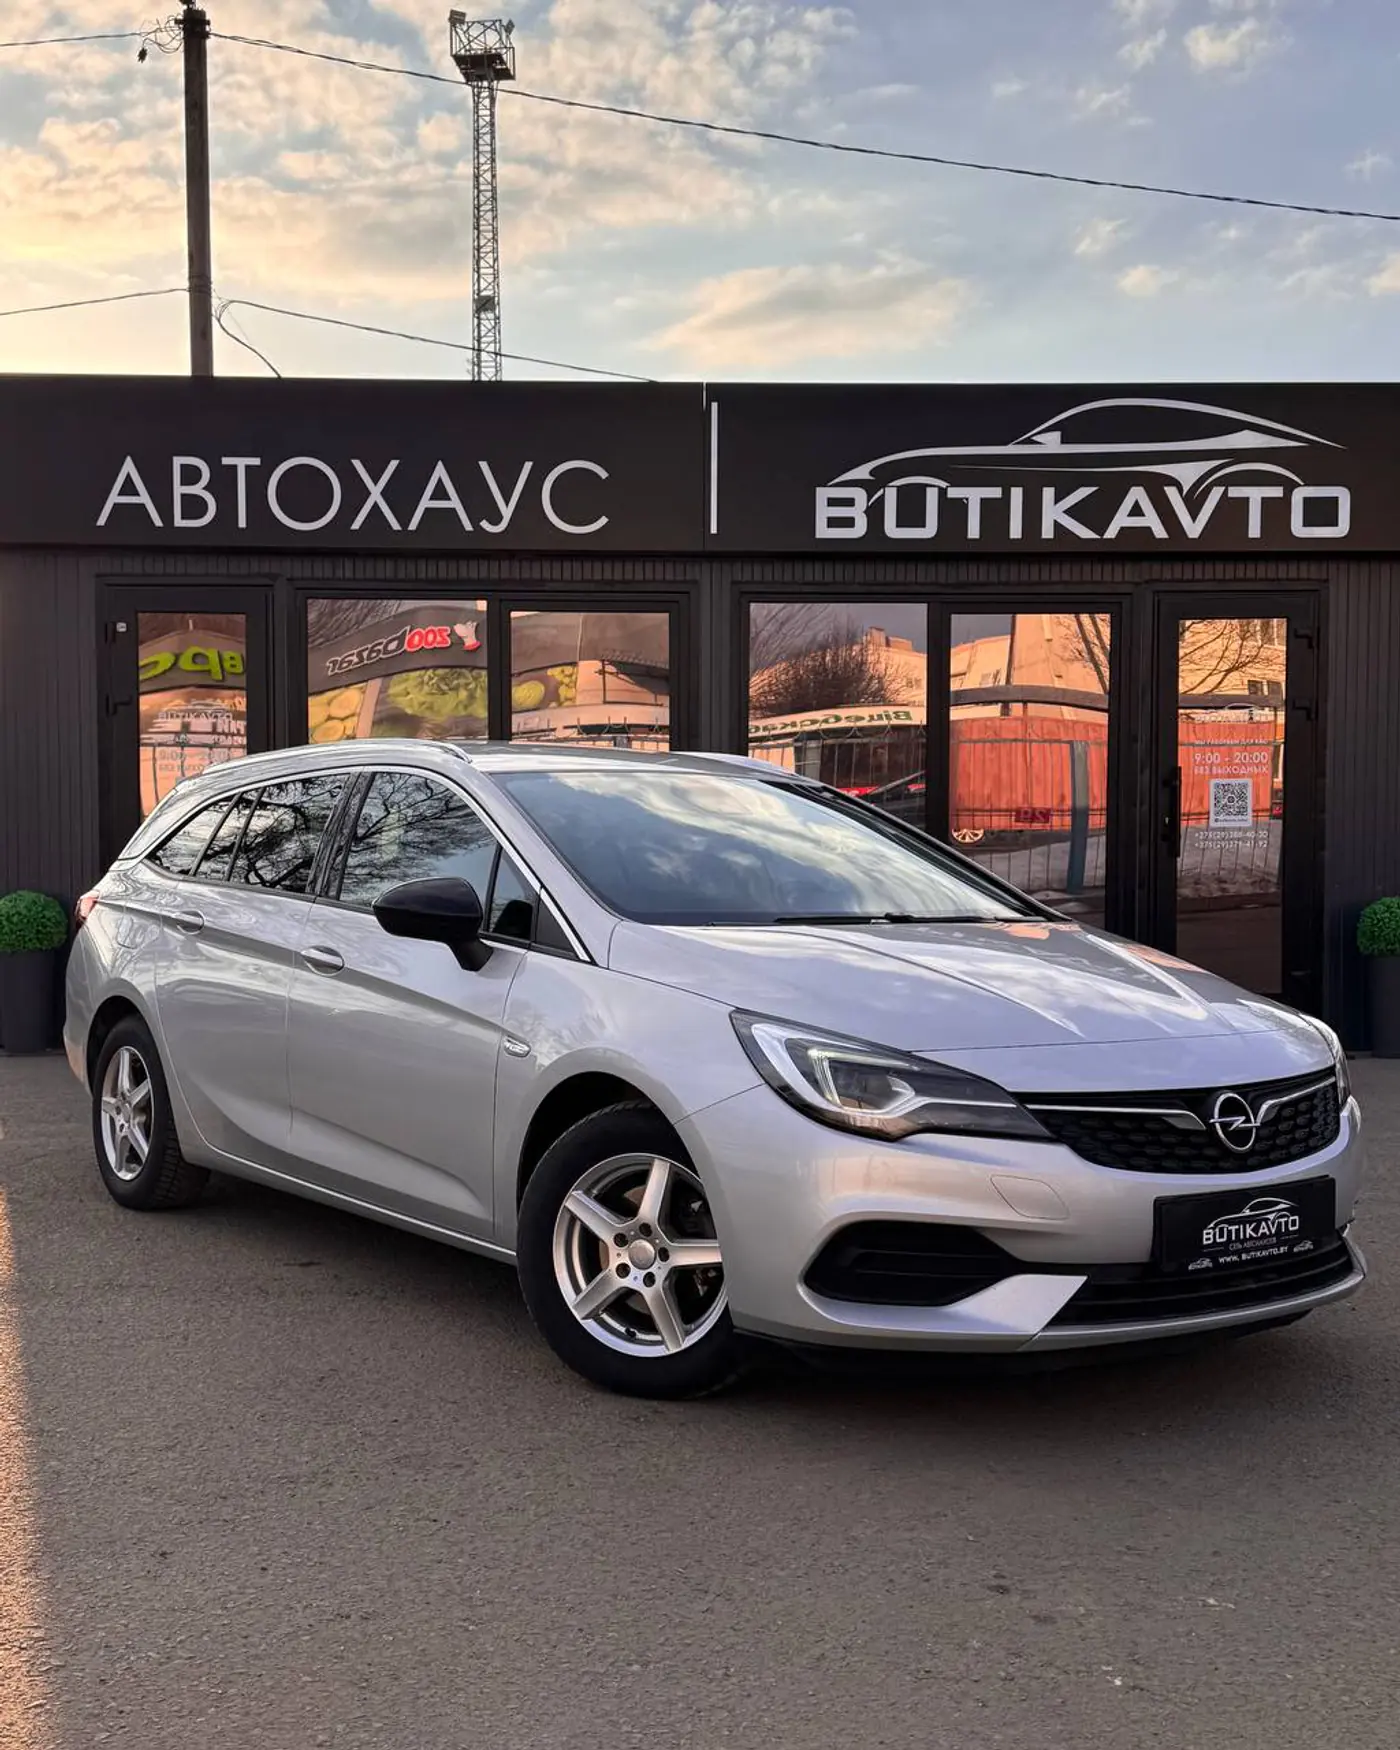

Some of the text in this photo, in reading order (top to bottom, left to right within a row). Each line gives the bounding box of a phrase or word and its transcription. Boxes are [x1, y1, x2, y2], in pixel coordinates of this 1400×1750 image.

[95, 455, 610, 535] АВТОХАУС
[814, 485, 1351, 539] BUTIKAVTO
[1194, 752, 1220, 763] 9:00
[1235, 752, 1268, 763] 20:00
[1203, 1215, 1299, 1245] BUTIKAVTO
